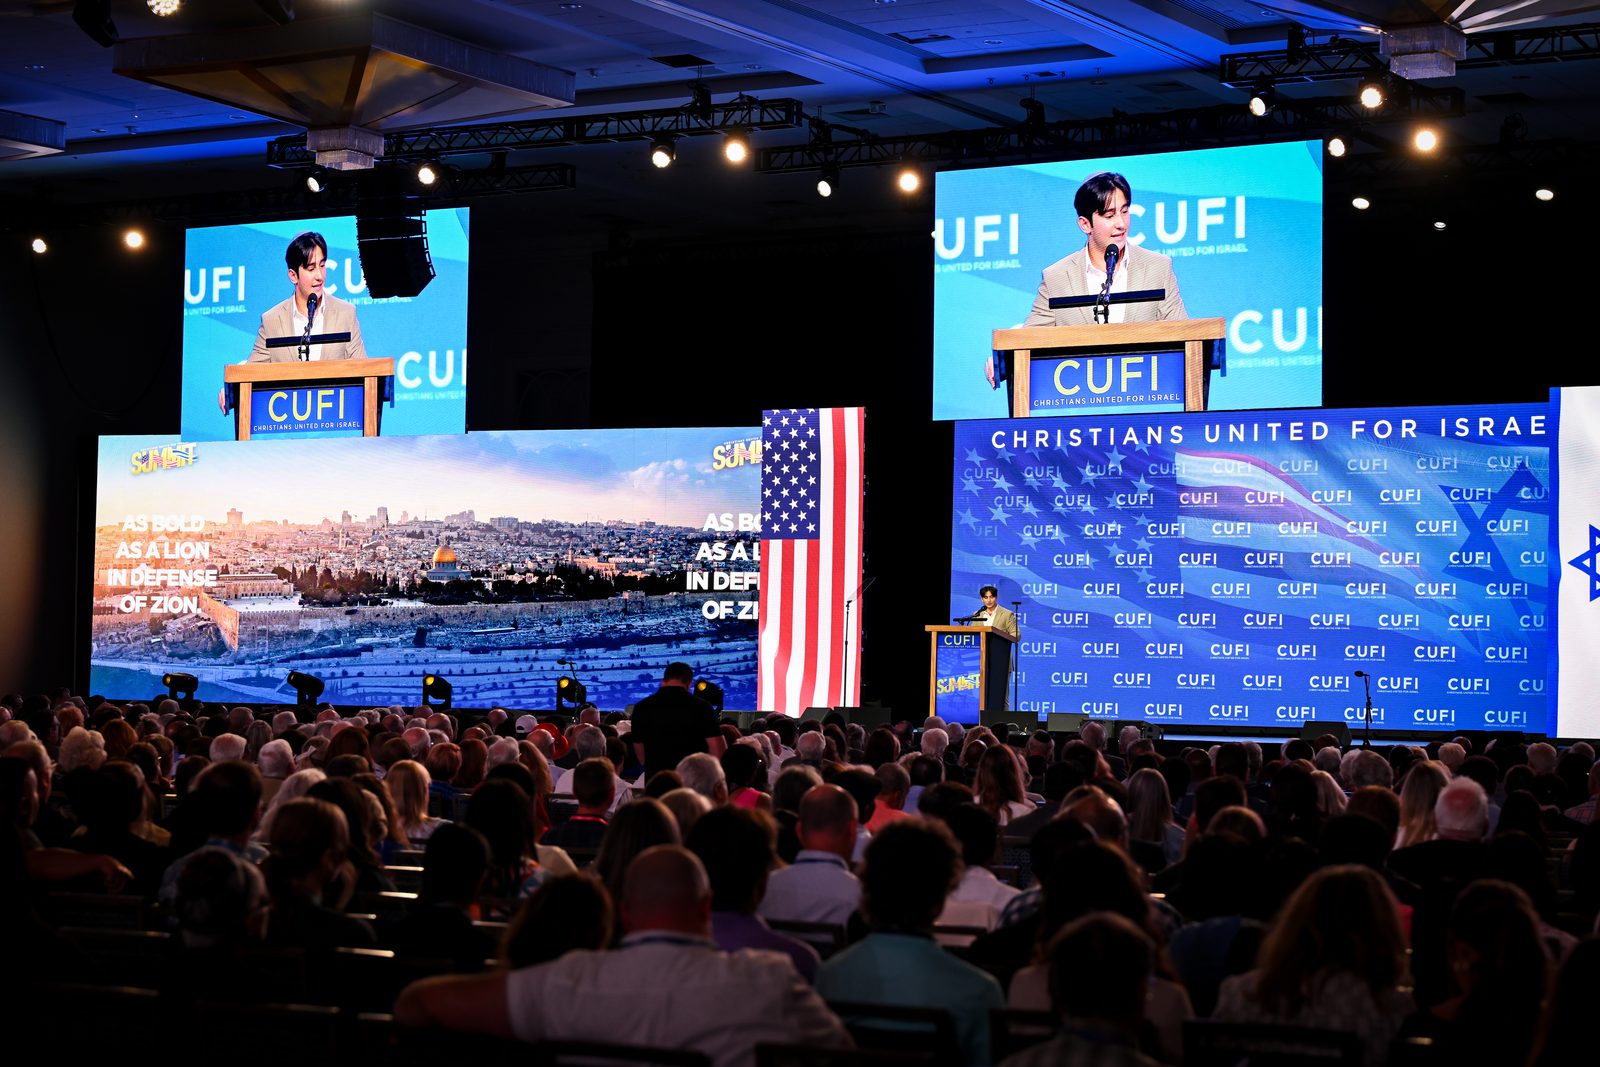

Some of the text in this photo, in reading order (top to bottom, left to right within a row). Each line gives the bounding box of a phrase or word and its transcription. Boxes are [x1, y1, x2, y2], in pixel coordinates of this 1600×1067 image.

[935, 213, 1018, 259] UFI
[1196, 246, 1215, 255] FOR
[1216, 244, 1248, 254] ISRAEL
[942, 262, 972, 272] UNITED
[974, 261, 991, 270] FOR
[992, 259, 1021, 270] ISRAEL
[323, 258, 366, 294] CU
[184, 266, 245, 304] UFI
[1054, 356, 1158, 396] CUFI
[268, 389, 344, 422] CUFI
[1034, 397, 1086, 407] CHRISTIANS
[1090, 396, 1123, 404] UNITED
[992, 416, 1546, 448] CHRISTIANS UNITED FOR ISRAE
[132, 443, 196, 474] SUMMIT
[713, 440, 762, 470] SUM
[1212, 462, 1252, 473] CUFI
[1280, 460, 1319, 472] CUFI
[1347, 459, 1388, 471] CUFI
[1416, 457, 1458, 469] CUFI
[1487, 456, 1529, 468] CUFI
[964, 468, 999, 479] CUFI
[1024, 466, 1060, 477] CUFI
[1085, 464, 1122, 476] CUFI
[1149, 464, 1186, 475] CUFI
[1180, 492, 1218, 504] CUFI
[1245, 491, 1284, 503] CUFI
[1312, 490, 1352, 502] CUFI
[1380, 490, 1421, 501] CUFI
[1450, 488, 1492, 500] CUFI
[1521, 487, 1549, 499] CU
[994, 496, 1029, 508] CUFI
[1054, 495, 1091, 506] CUFI
[1116, 494, 1154, 505] CUFI
[122, 514, 205, 532] AS BOLD
[702, 512, 734, 532] AS
[1278, 522, 1318, 534] CUFI
[1346, 521, 1387, 533] CUFI
[1416, 520, 1457, 532] CUFI
[1486, 520, 1529, 532] CUFI
[973, 526, 998, 536] UFI
[1023, 525, 1059, 536] CUFI
[1084, 525, 1121, 536] CUFI
[1148, 524, 1185, 535] CUFI
[1212, 523, 1252, 534] CUFI
[116, 541, 209, 559] AS A LION
[695, 542, 727, 560] AS
[730, 542, 748, 560] A
[992, 555, 1028, 566] CUFI
[1053, 554, 1090, 566] CUFI
[1115, 554, 1153, 565] CUFI
[1179, 553, 1217, 564] CUFI
[1244, 552, 1283, 564] CUFI
[1311, 552, 1351, 564] CUFI
[1379, 552, 1420, 564] CUFI
[1449, 552, 1491, 564] CUFI
[1520, 551, 1545, 564] CU
[108, 569, 218, 586] IN DEFENSE
[686, 571, 708, 590] IN
[1022, 583, 1058, 595] CUFI
[1083, 583, 1120, 595] CUFI
[1146, 583, 1184, 595] CUFI
[1211, 583, 1250, 595] CUFI
[1278, 583, 1317, 595] CUFI
[1345, 583, 1386, 595] CUFI
[1415, 583, 1457, 595] CUFI
[1486, 583, 1528, 595] CUFI
[120, 596, 202, 614] OF ZION.
[702, 600, 734, 620] OF
[1052, 613, 1089, 625] CUFI
[1114, 613, 1152, 625] CUFI
[1178, 614, 1216, 625] CUFI
[1244, 614, 1283, 626] CUFI
[1310, 614, 1350, 626] CUFI
[1378, 614, 1419, 627] CUFI
[1449, 615, 1490, 627] CUFI
[1520, 615, 1544, 628] CU
[944, 635, 975, 645] CUFI
[1021, 642, 1057, 654] CUFI
[1082, 643, 1119, 655] CUFI
[1146, 644, 1183, 655] CUFI
[1210, 644, 1250, 656] CUFI
[1277, 645, 1316, 657] CUFI
[1345, 646, 1385, 657] CUFI
[1414, 646, 1456, 658] CUFI
[1485, 647, 1527, 659] CUFI
[1051, 672, 1088, 684] CUFI
[1114, 673, 1151, 685] CUFI
[1176, 674, 1215, 686] CUFI
[1243, 675, 1282, 687] CUFI
[1309, 676, 1349, 688] CUFI
[1378, 677, 1419, 689] CUFI
[1448, 678, 1490, 691] CUFI
[1519, 679, 1544, 691] CU
[1019, 701, 1056, 713] CUFI
[1082, 702, 1118, 714] CUFI
[1145, 704, 1182, 716] CUFI
[1210, 705, 1249, 717] CUFI
[1276, 706, 1316, 718] CUFI
[1344, 708, 1384, 720] CUFI
[1414, 709, 1455, 721] CUFI
[1484, 711, 1527, 723] CUFI
